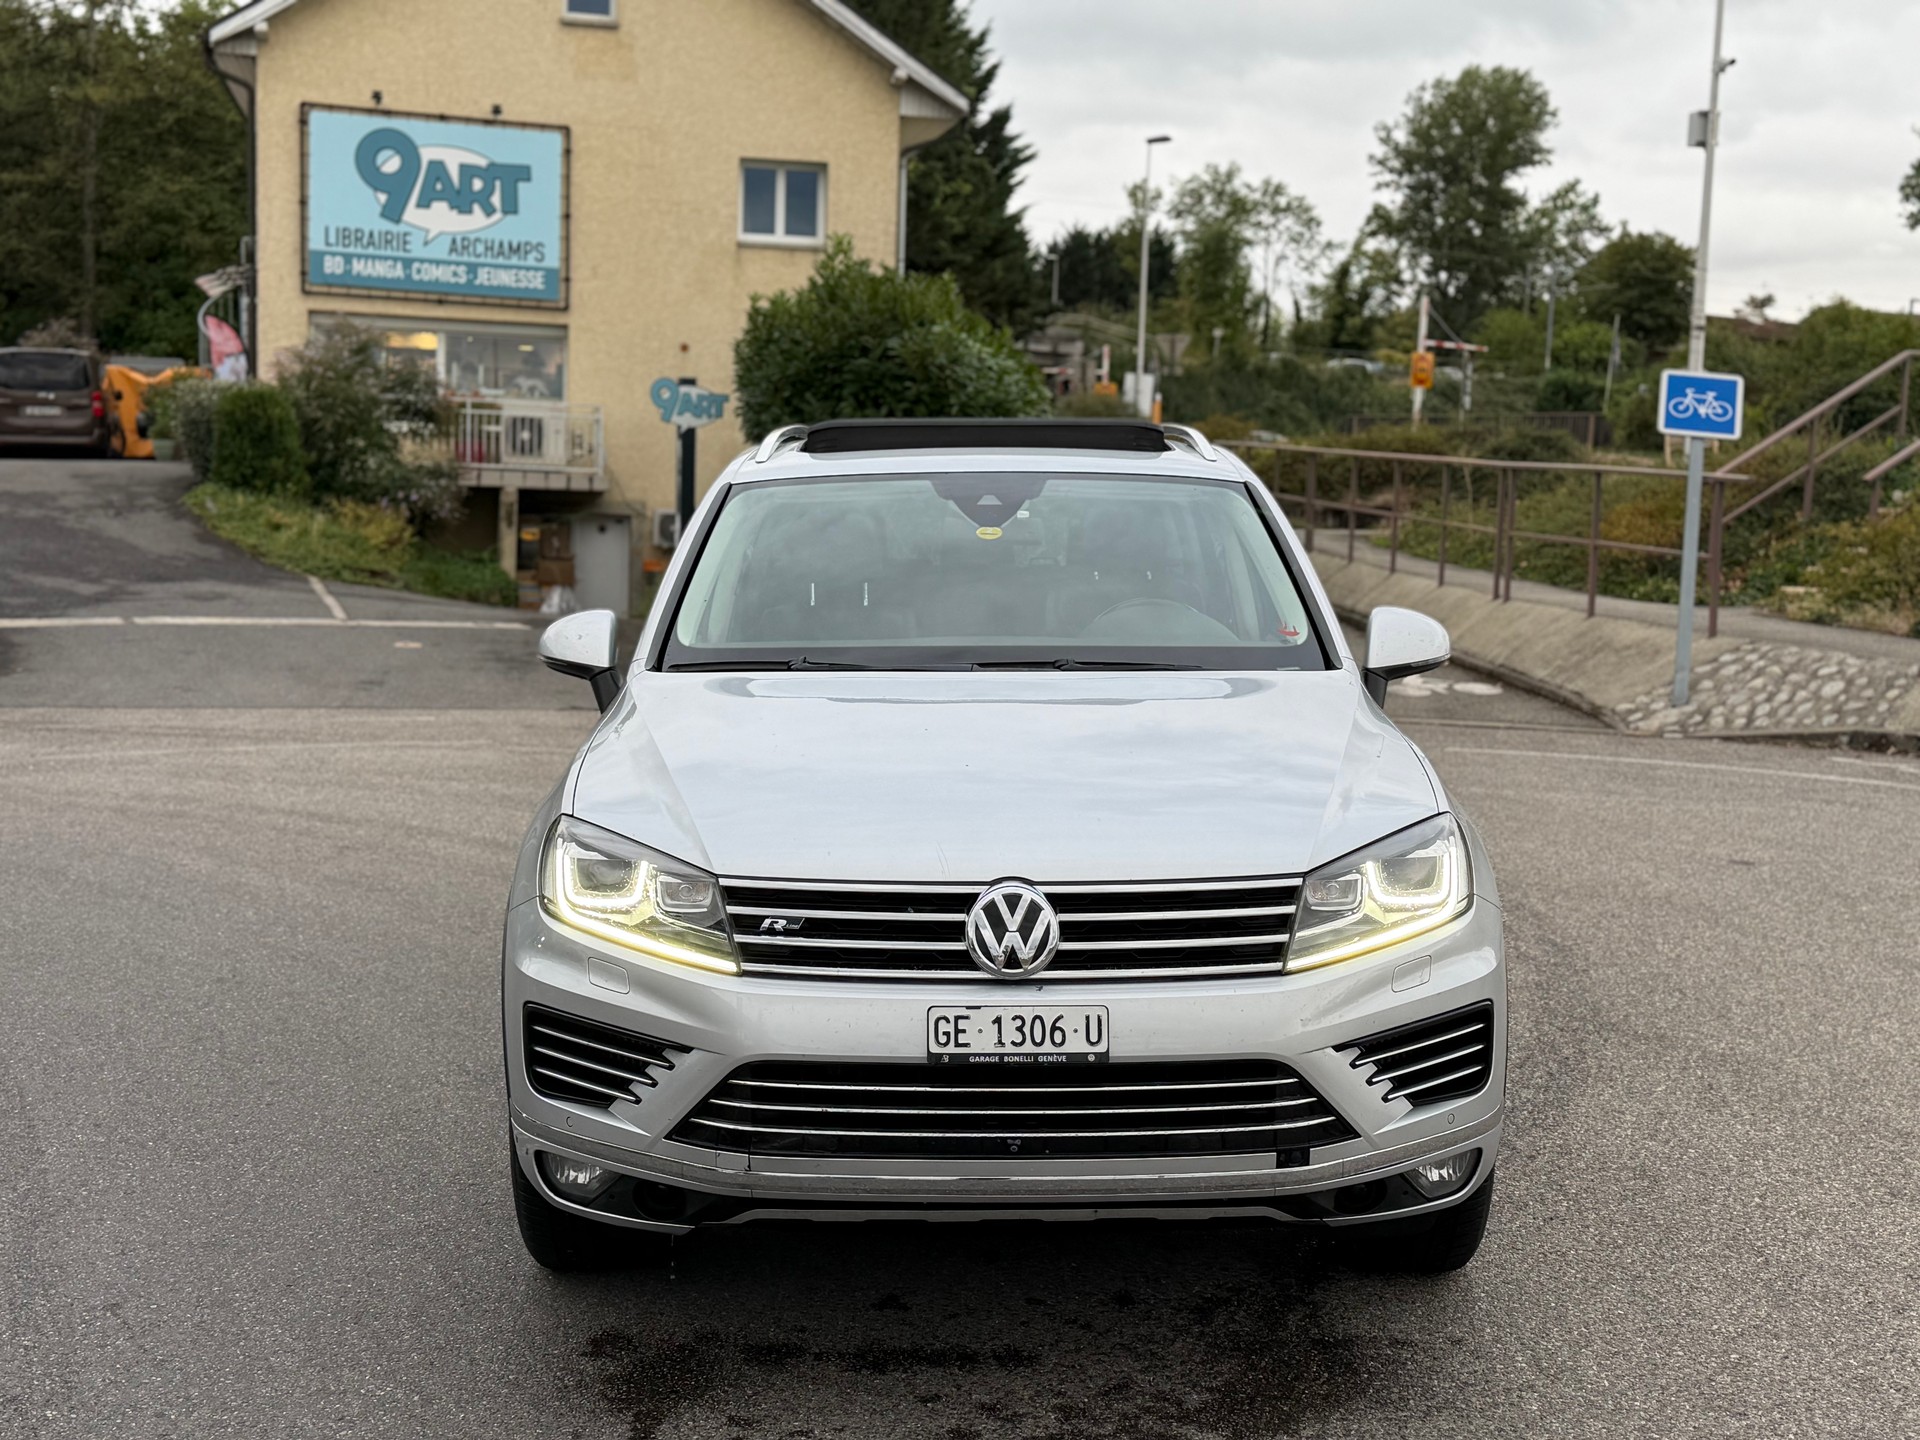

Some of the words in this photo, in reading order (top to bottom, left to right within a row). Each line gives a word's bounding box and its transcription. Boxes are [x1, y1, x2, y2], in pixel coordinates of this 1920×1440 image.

[324, 226, 412, 253] LIBRAIRIE
[448, 236, 546, 263] ARCHAMPS
[351, 257, 405, 280] MANGA
[411, 261, 468, 285] COMICS
[473, 266, 546, 290] JEUNESSE
[1037, 1054, 1067, 1063] GENÈVE
